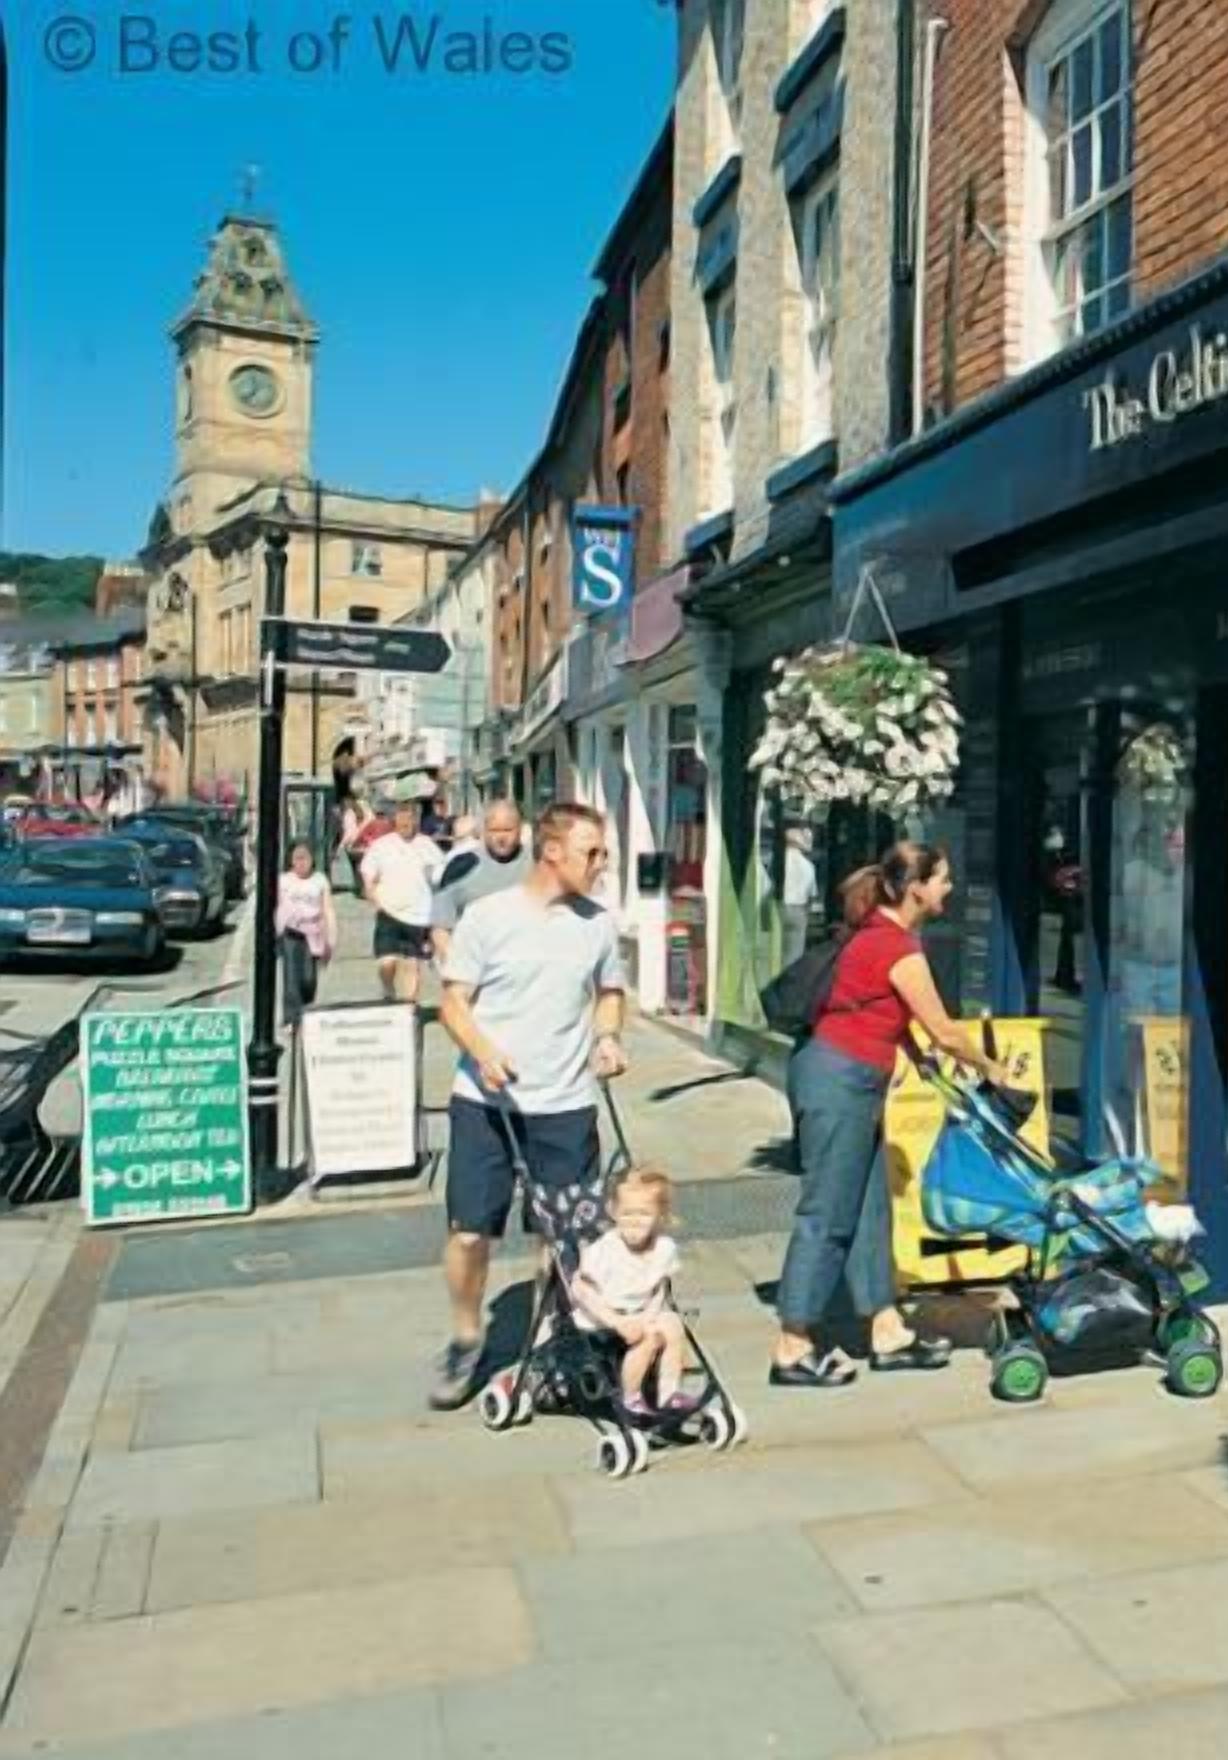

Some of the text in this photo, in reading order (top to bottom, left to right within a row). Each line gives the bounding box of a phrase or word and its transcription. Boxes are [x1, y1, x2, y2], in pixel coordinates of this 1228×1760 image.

[1083, 365, 1146, 452] The
[92, 1016, 234, 1046] PEPPERS
[123, 1157, 214, 1190] OPEN
